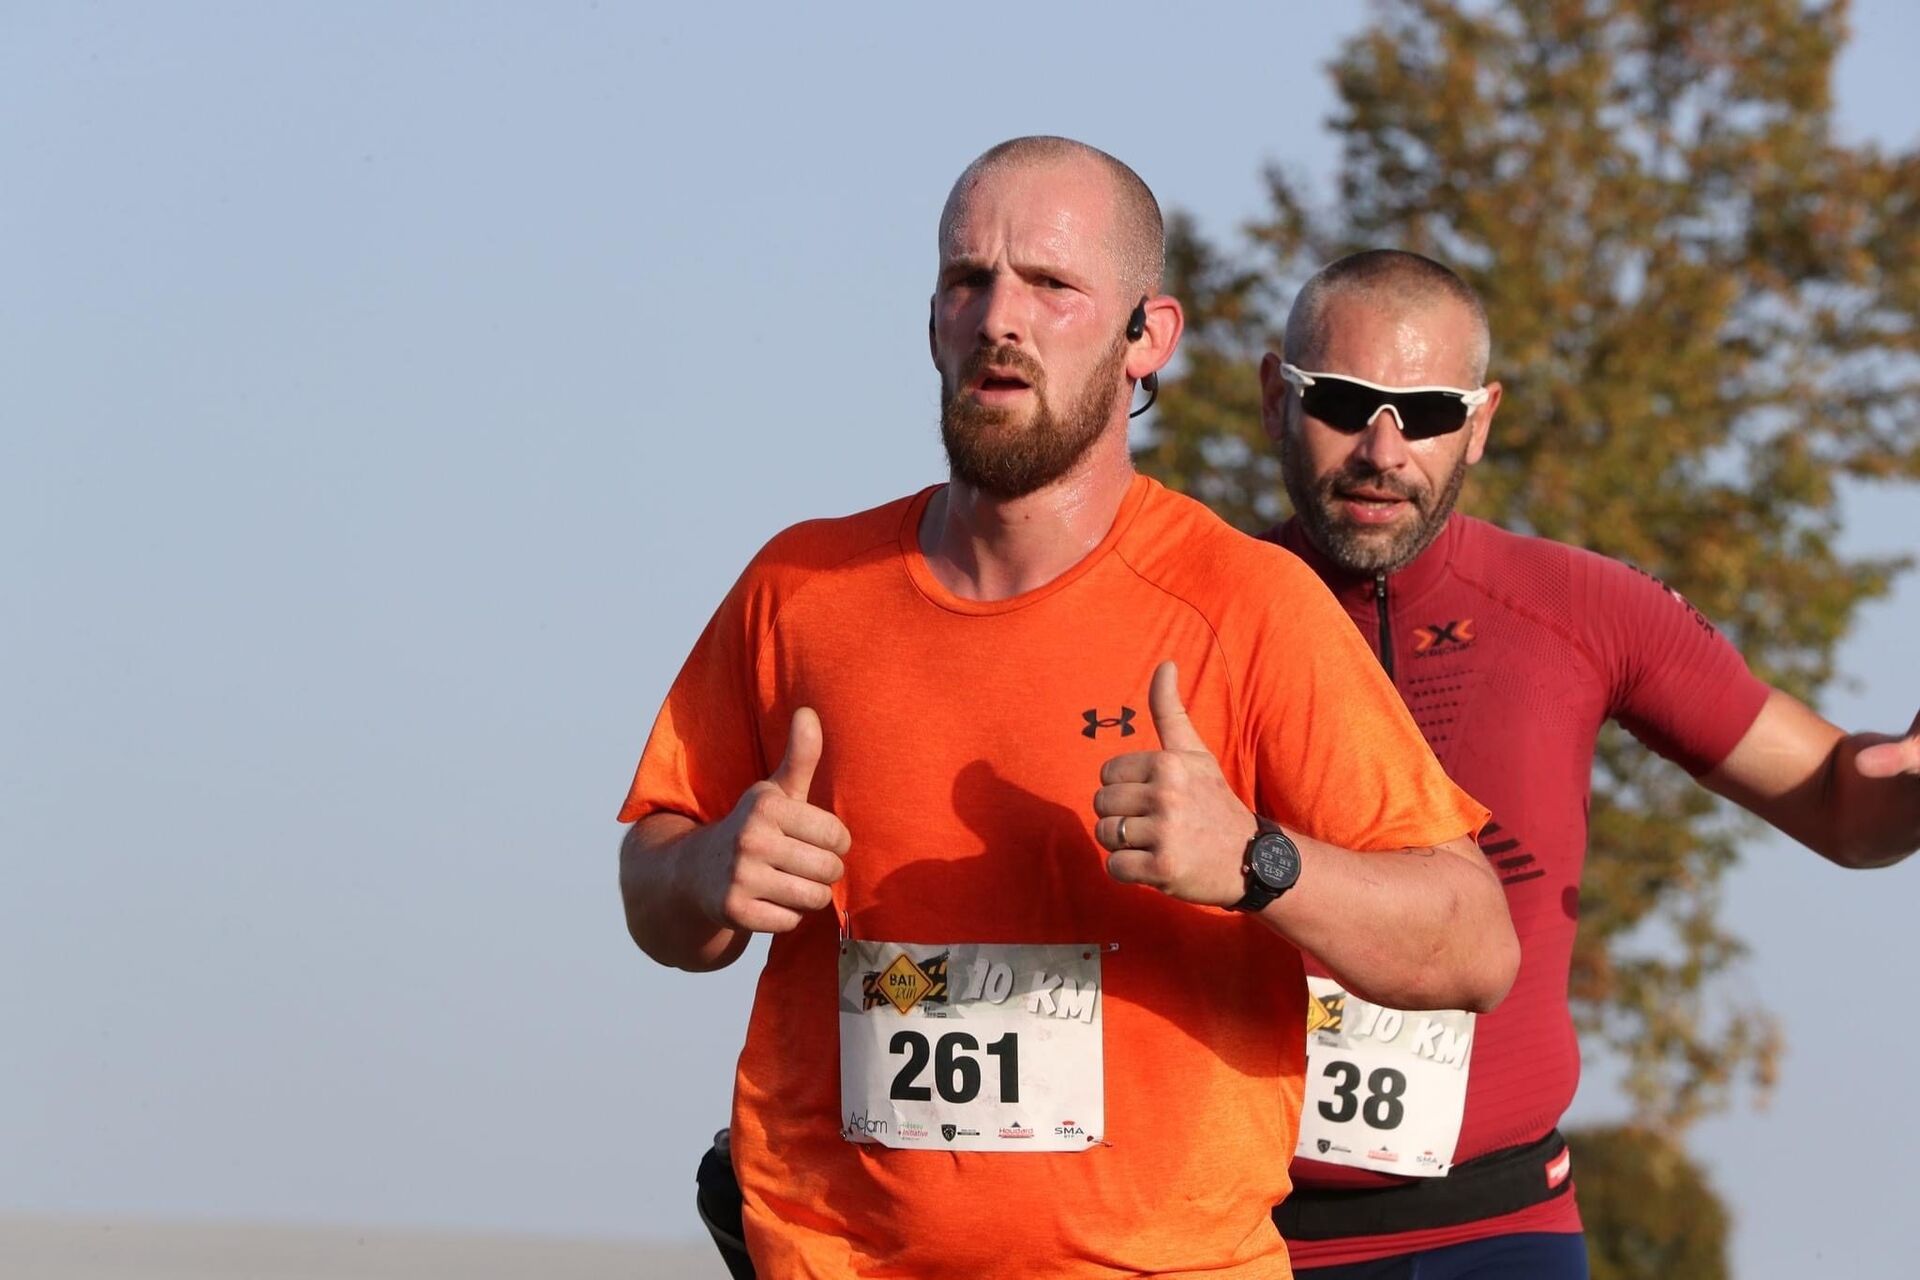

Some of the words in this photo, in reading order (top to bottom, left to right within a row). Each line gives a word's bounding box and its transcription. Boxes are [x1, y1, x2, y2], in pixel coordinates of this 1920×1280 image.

[889, 974, 916, 986] BATI
[964, 958, 1014, 1004] 10
[1028, 970, 1097, 1024] KM
[889, 1030, 1020, 1104] 261
[1353, 1004, 1403, 1043] 10
[1411, 1018, 1470, 1068] KM
[1317, 1060, 1407, 1130] 38
[1054, 1127, 1085, 1135] SMA
